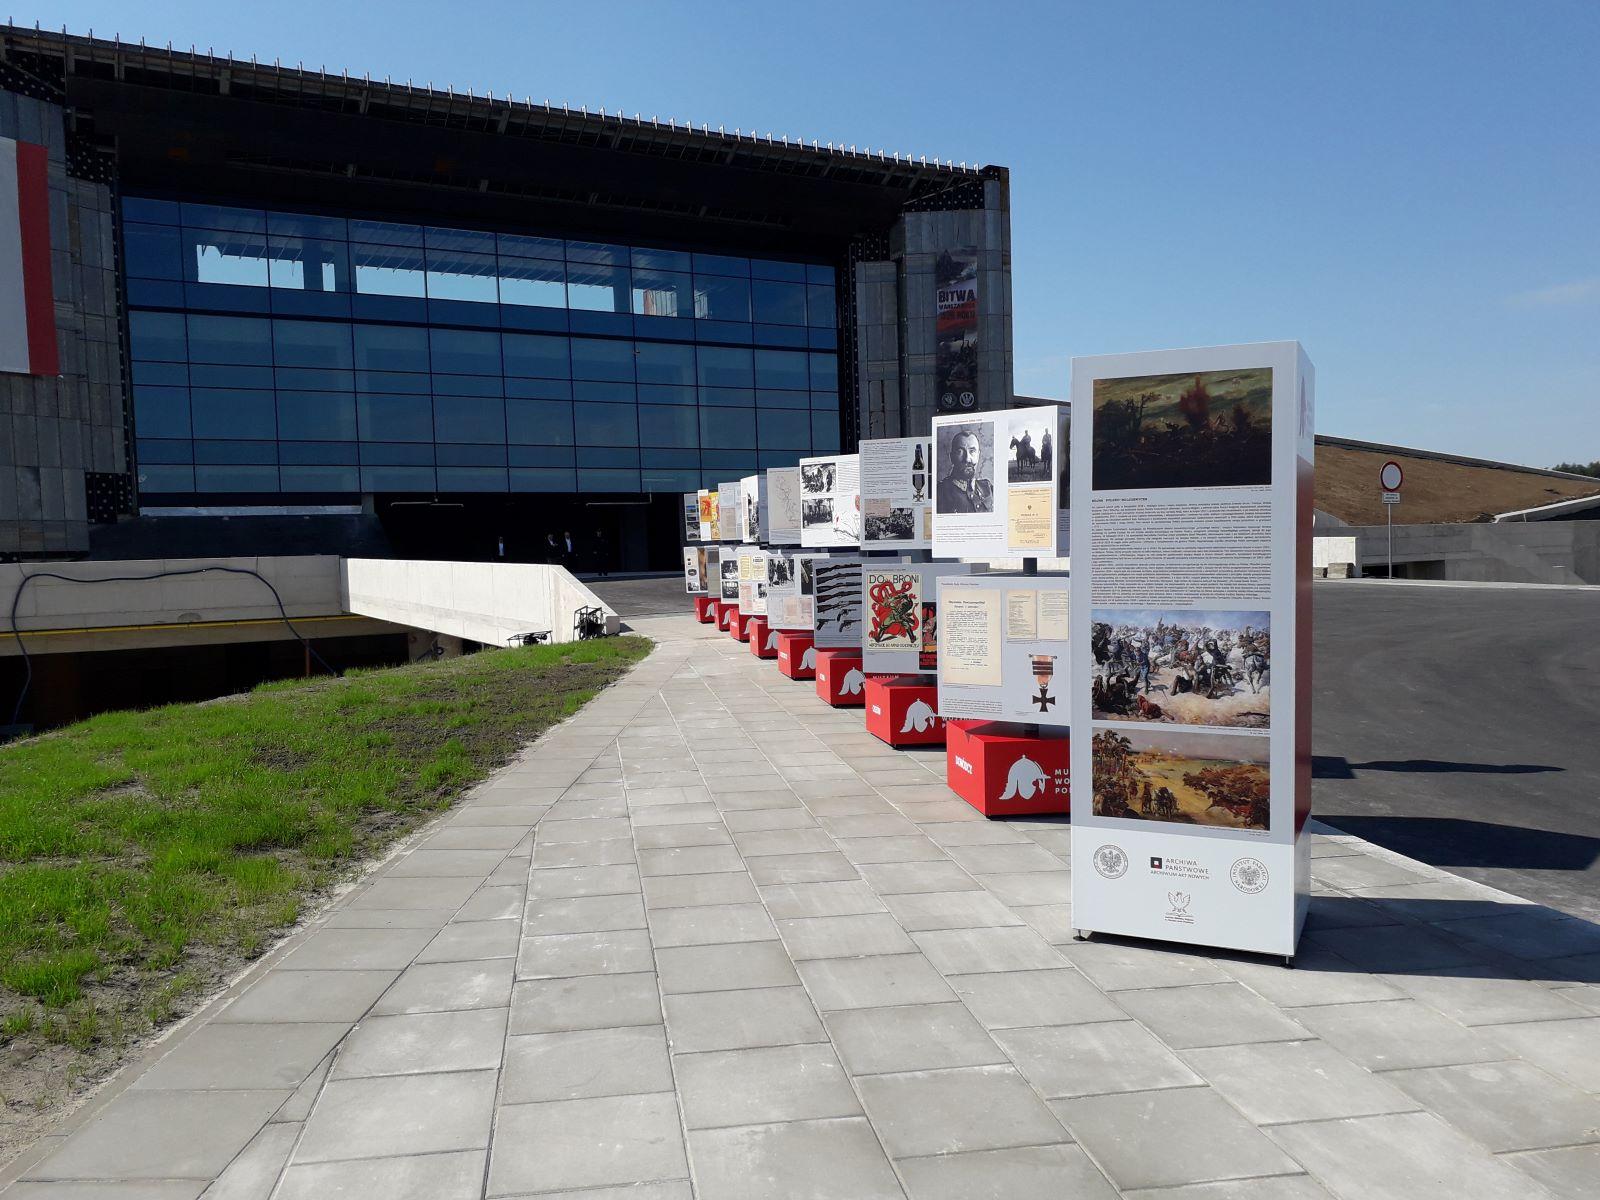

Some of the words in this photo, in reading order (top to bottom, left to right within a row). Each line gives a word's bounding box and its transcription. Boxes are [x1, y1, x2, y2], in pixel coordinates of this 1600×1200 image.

[938, 289, 975, 303] BITWA
[869, 574, 885, 584] DO
[892, 574, 919, 584] BRONI
[1165, 858, 1197, 866] ARCHIWA
